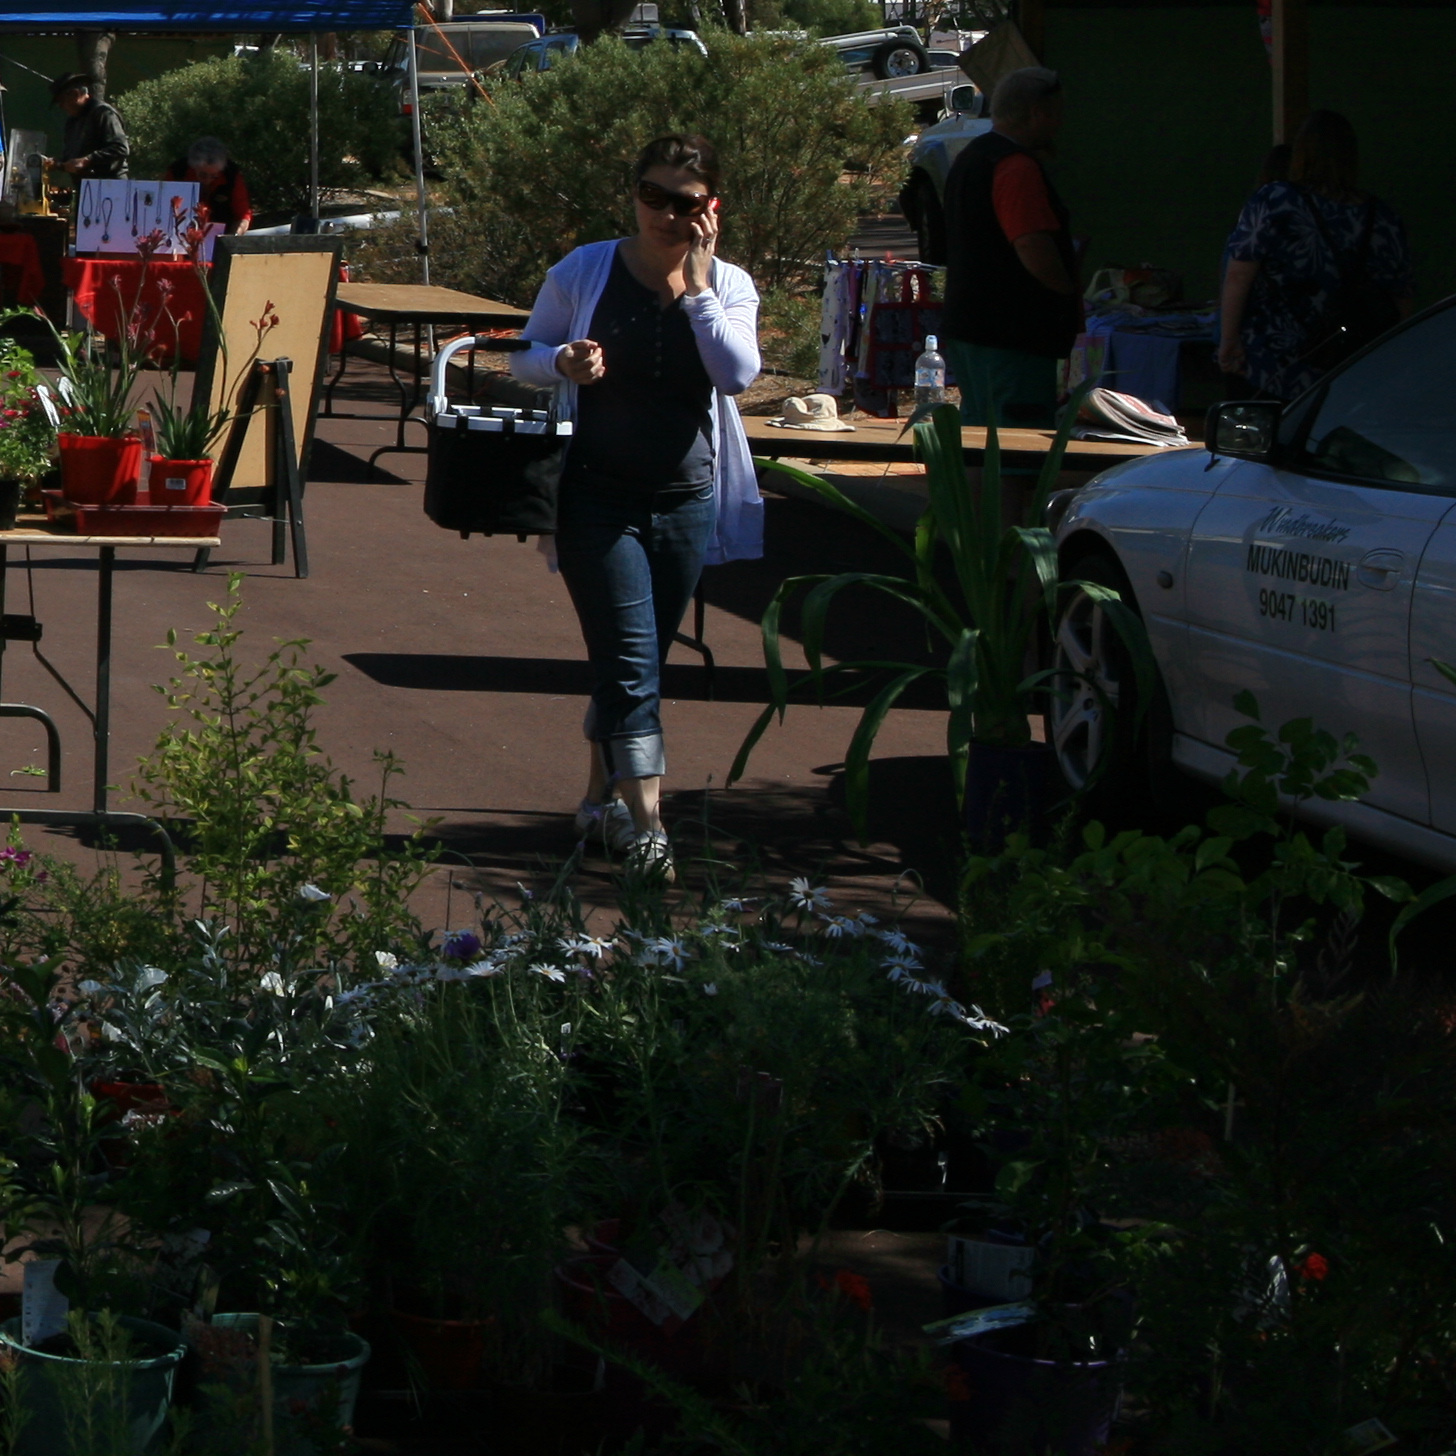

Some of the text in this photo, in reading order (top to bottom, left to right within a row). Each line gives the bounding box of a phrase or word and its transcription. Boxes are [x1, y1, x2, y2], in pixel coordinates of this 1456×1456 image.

[1247, 544, 1351, 591] MUKINBUDIN
[1259, 588, 1335, 632] 9047 1391
